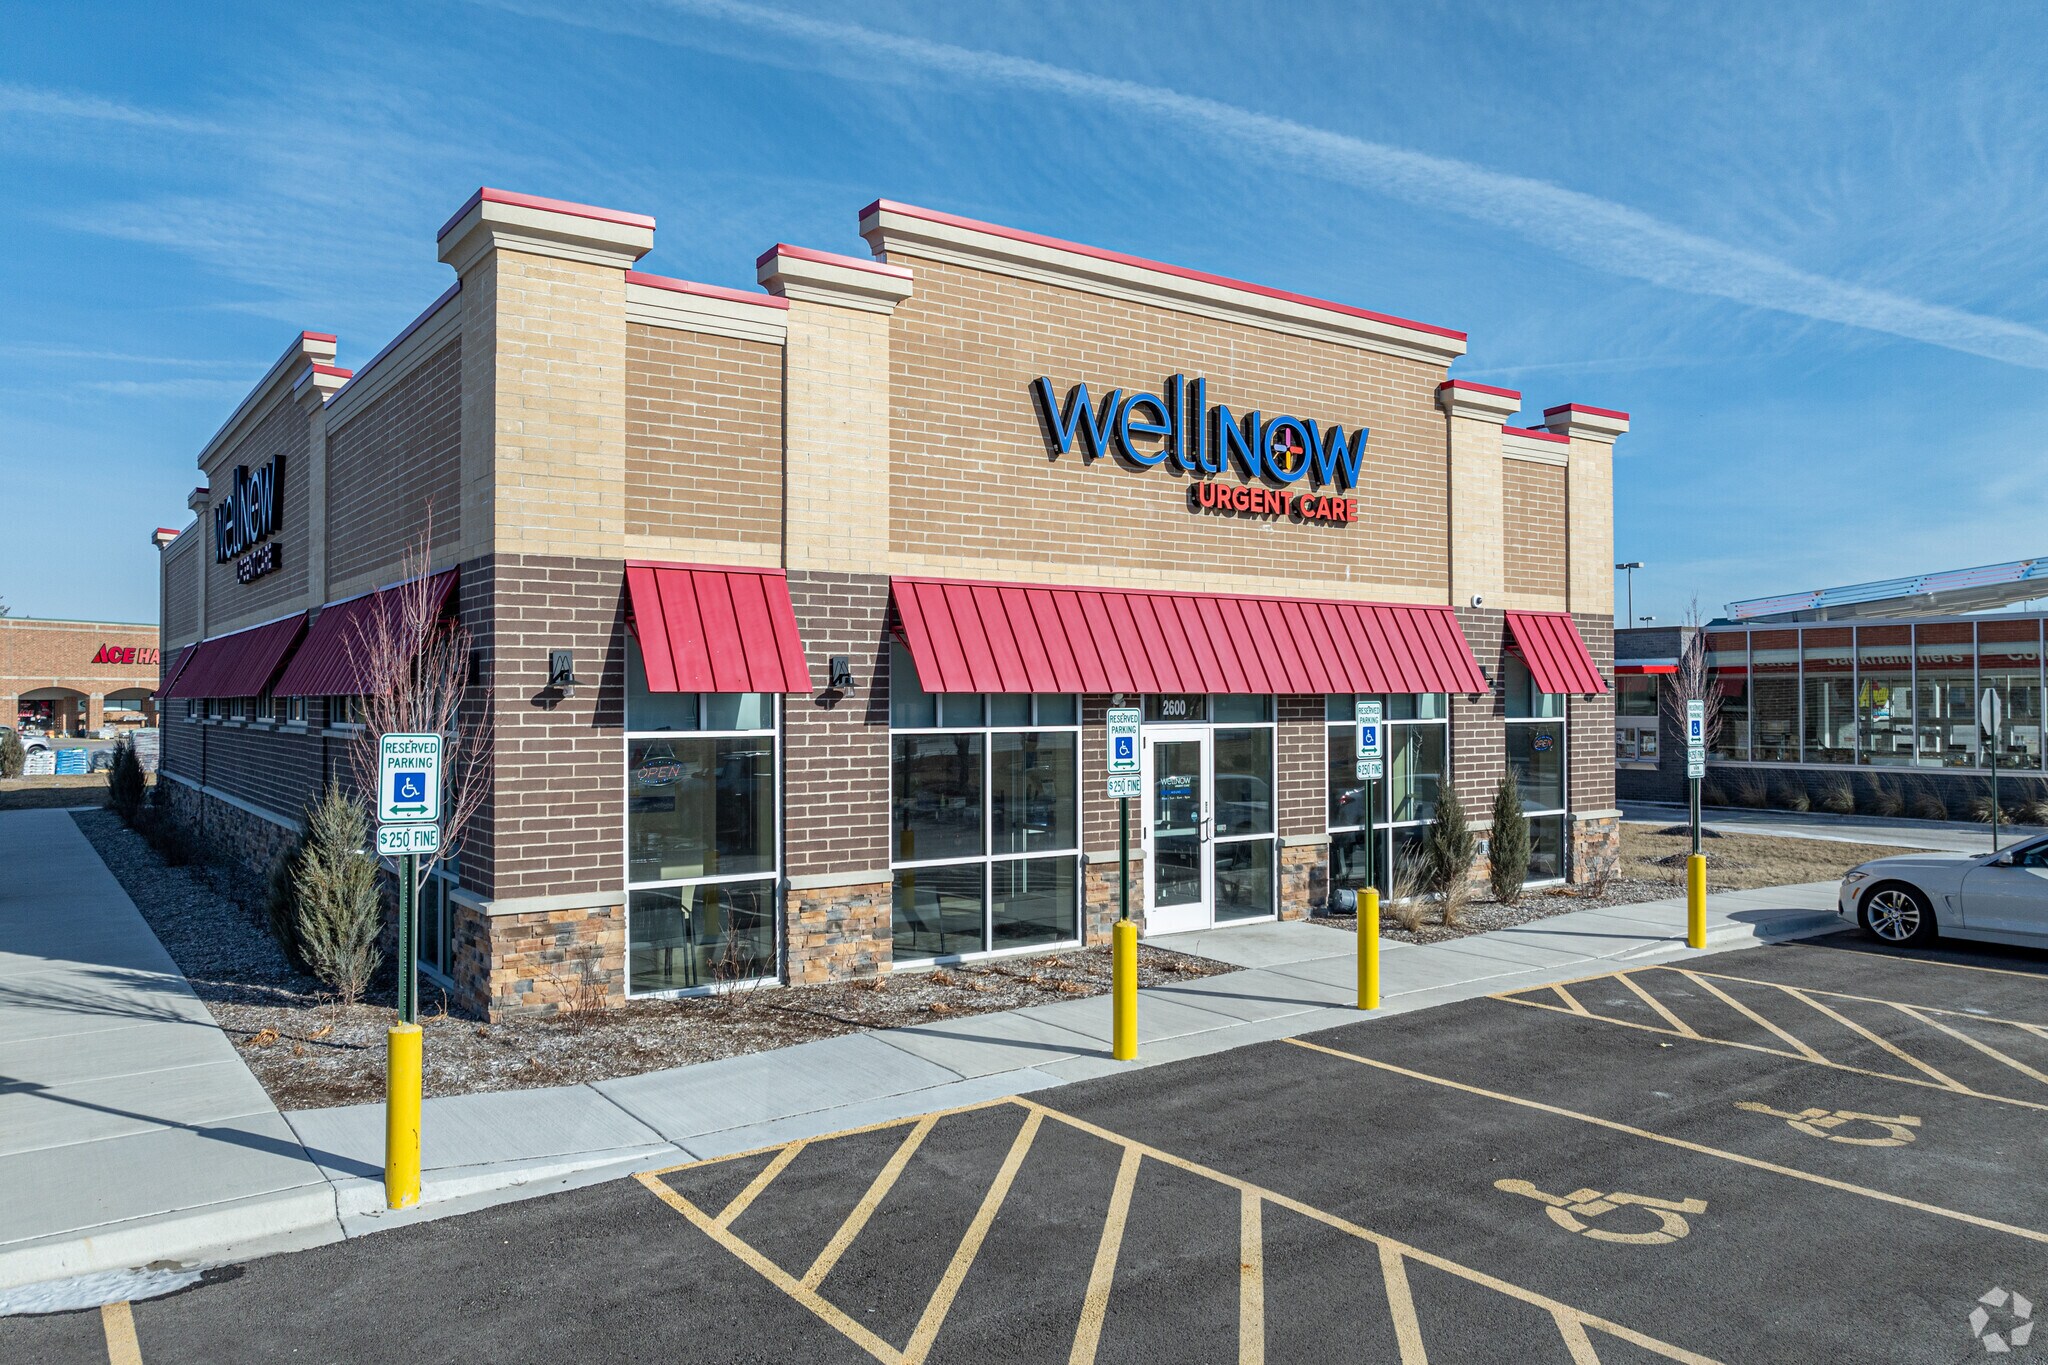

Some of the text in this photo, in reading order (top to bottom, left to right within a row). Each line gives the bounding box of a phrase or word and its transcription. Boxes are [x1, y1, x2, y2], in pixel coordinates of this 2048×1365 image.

[1197, 481, 1358, 522] URGENT CARE
[91, 643, 136, 664] ACE
[1162, 699, 1186, 716] 2600
[1358, 707, 1380, 715] RESERVED
[1109, 714, 1138, 723] RESERVED
[1111, 725, 1136, 734] PARKING
[385, 742, 437, 754] RESERVED
[388, 758, 433, 768] PARKING
[1358, 763, 1382, 776] $250 FINE
[637, 766, 681, 779] OPEN
[1108, 779, 1141, 792] $250 FINE
[380, 830, 437, 848] $250 FINE
